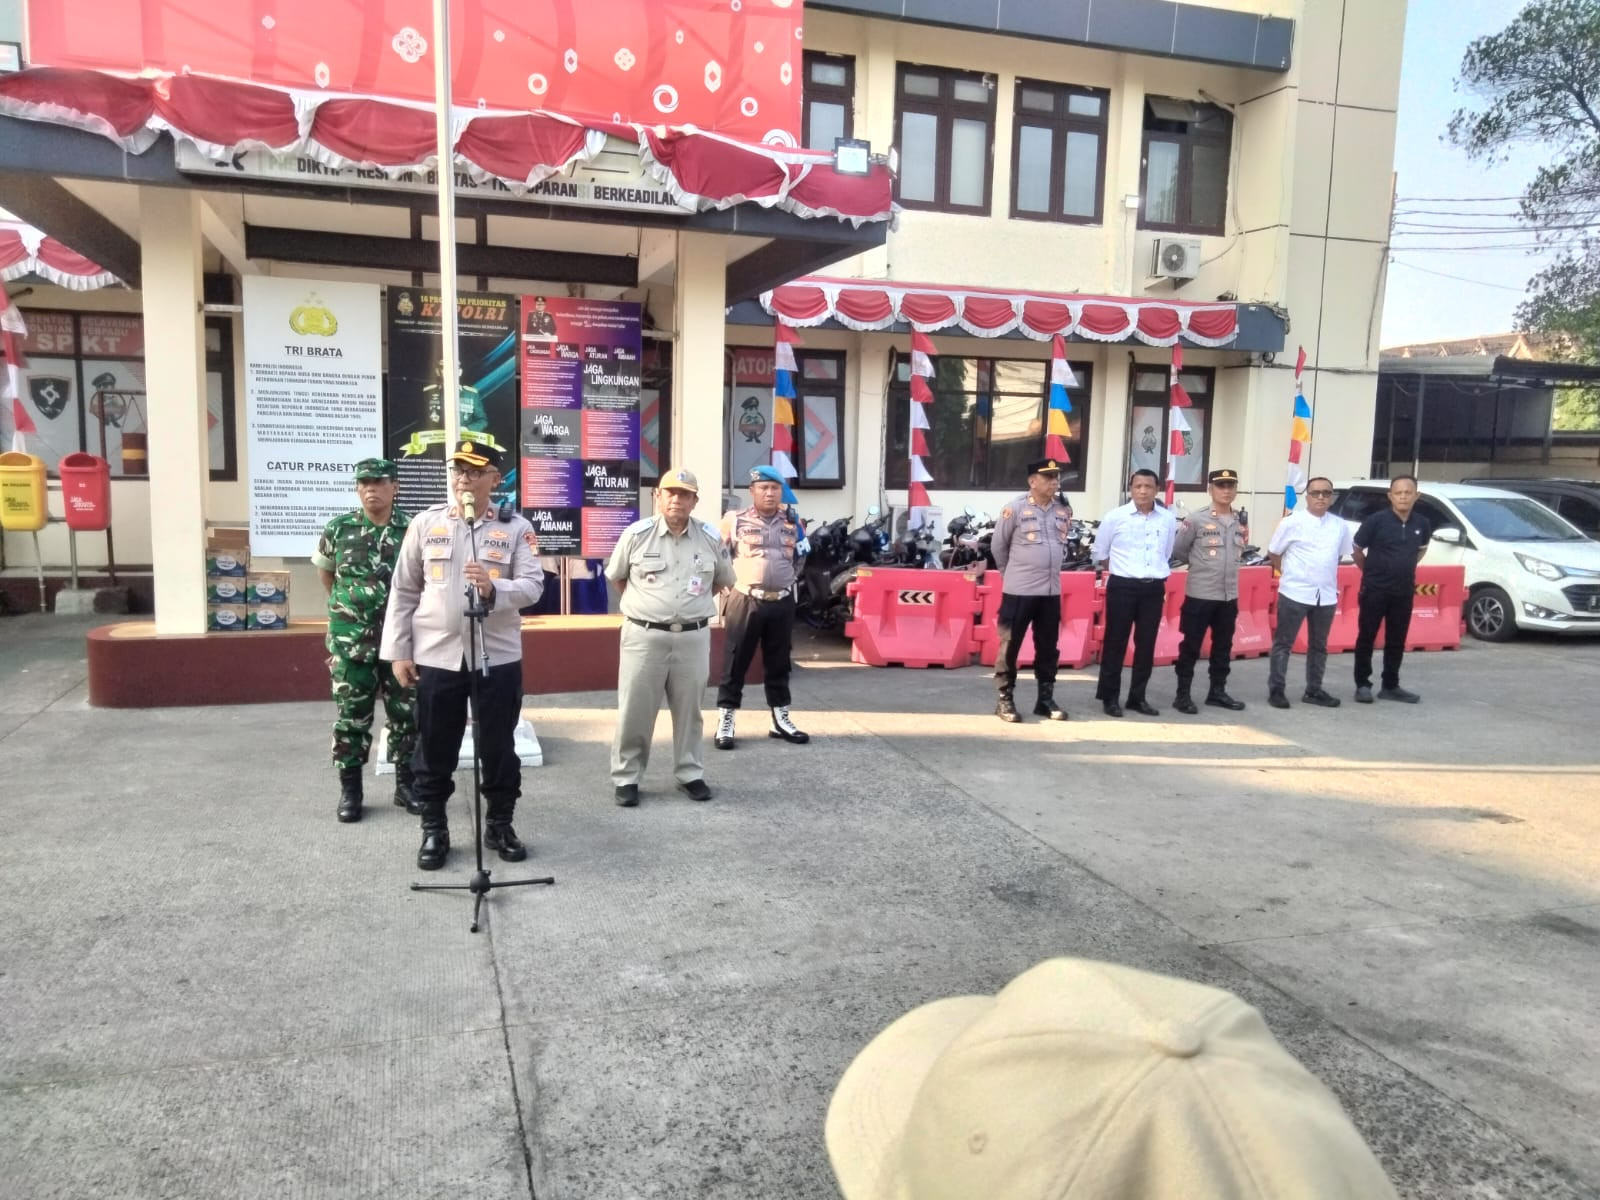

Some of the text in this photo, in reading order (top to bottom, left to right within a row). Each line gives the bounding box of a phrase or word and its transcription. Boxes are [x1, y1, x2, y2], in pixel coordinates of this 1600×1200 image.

[420, 304, 506, 320] KAOLRI
[285, 346, 343, 357] TRI BRATA
[584, 363, 604, 375] JAGA
[591, 374, 639, 386] LINGKUNGAN
[534, 414, 554, 425] JAGA
[542, 425, 570, 436] WARGA
[267, 461, 356, 472] CATUR PRASETY
[585, 465, 607, 477] JAGA
[594, 477, 629, 488] ATURAN
[532, 510, 552, 521] JAGA
[540, 521, 573, 531] AMANAH
[484, 540, 510, 549] POLRI
